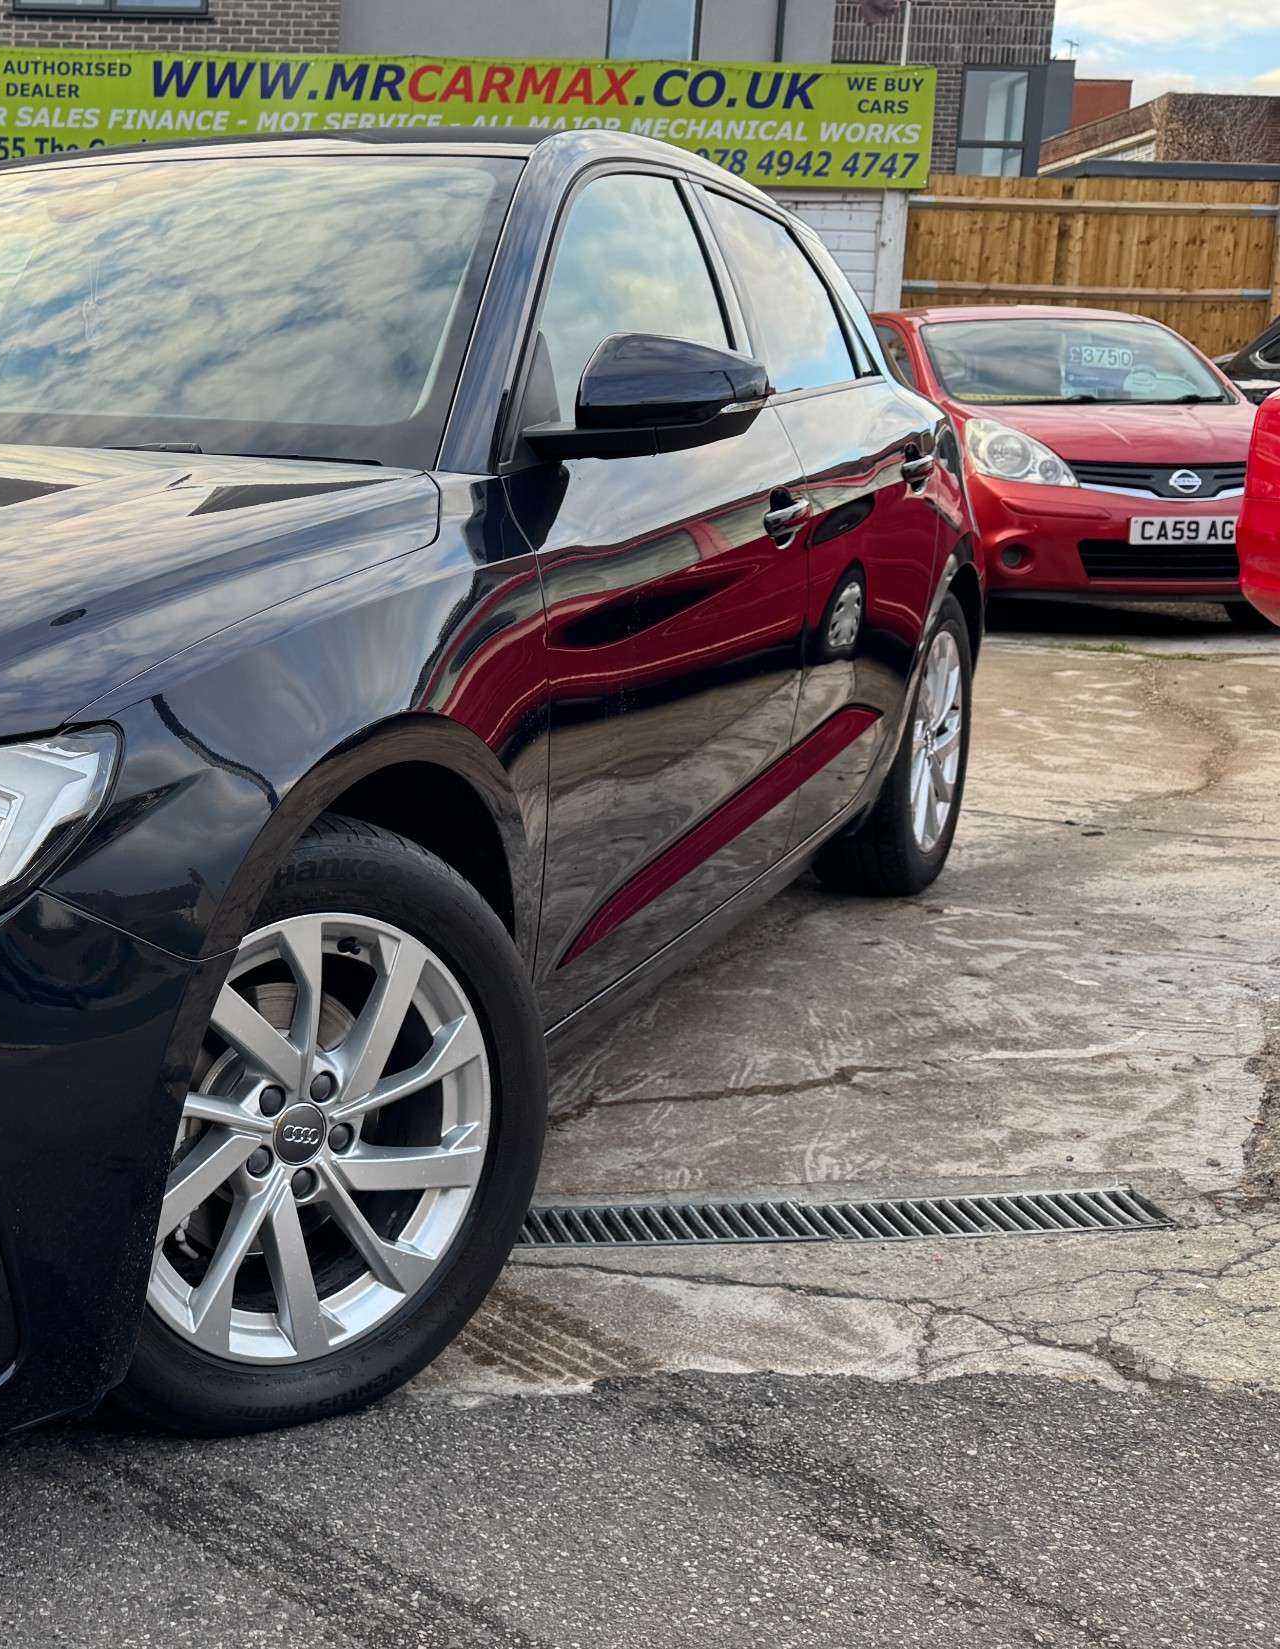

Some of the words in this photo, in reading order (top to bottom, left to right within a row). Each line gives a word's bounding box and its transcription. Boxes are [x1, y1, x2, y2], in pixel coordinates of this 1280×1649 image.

[3, 60, 133, 78] AUTHORISED
[5, 82, 80, 99] DEALER
[152, 60, 823, 110] WWW.MRCARMAX.CO.UK
[847, 76, 883, 93] WE
[885, 77, 925, 94] BUY
[857, 98, 910, 115] CARS
[14, 107, 103, 130] SALES
[108, 109, 230, 132] FINANCE
[257, 112, 318, 132] MOT
[629, 117, 809, 142] MECHANICAL
[818, 122, 922, 145] WORKS
[757, 149, 833, 177] 4942
[841, 151, 920, 179] 4747
[1141, 520, 1199, 540] CA59
[1207, 520, 1235, 540] AG
